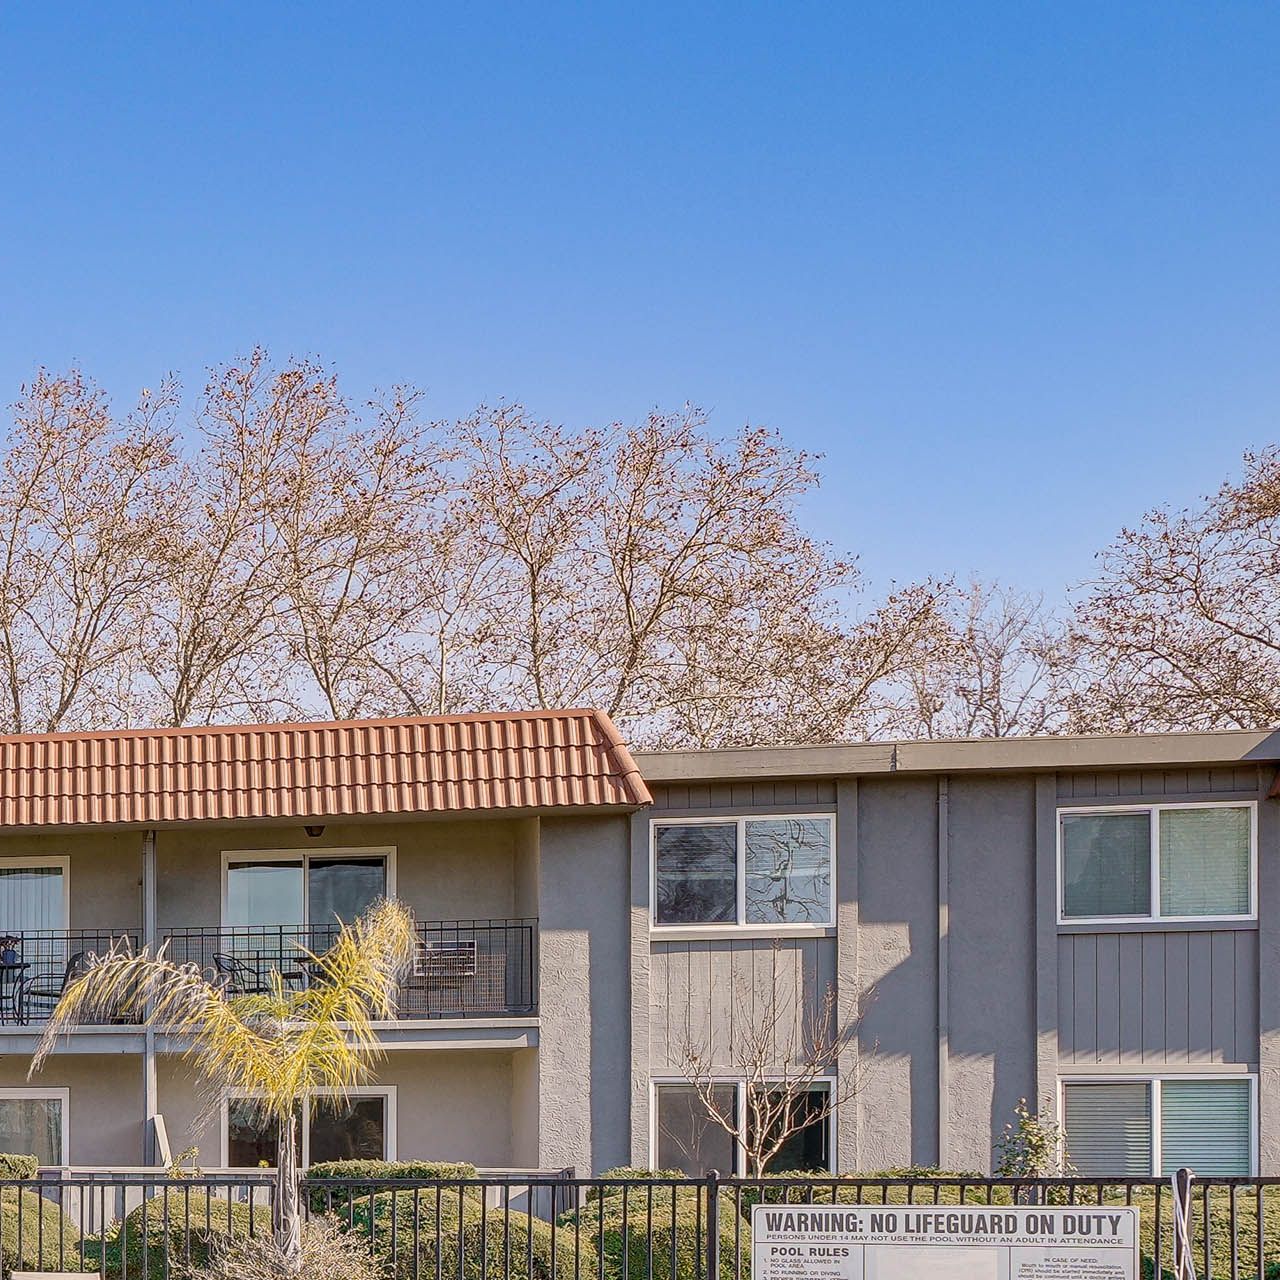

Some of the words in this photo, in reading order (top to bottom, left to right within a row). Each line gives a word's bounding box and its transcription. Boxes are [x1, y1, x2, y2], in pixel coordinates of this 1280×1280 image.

[765, 1213, 863, 1233] WARNING:
[871, 1213, 897, 1233] NO
[905, 1213, 1018, 1234] LIFEGUARD
[1025, 1214, 1054, 1235] ON
[1063, 1215, 1121, 1235] DUTY
[771, 1247, 804, 1256] POOL
[809, 1248, 849, 1256] RULES
